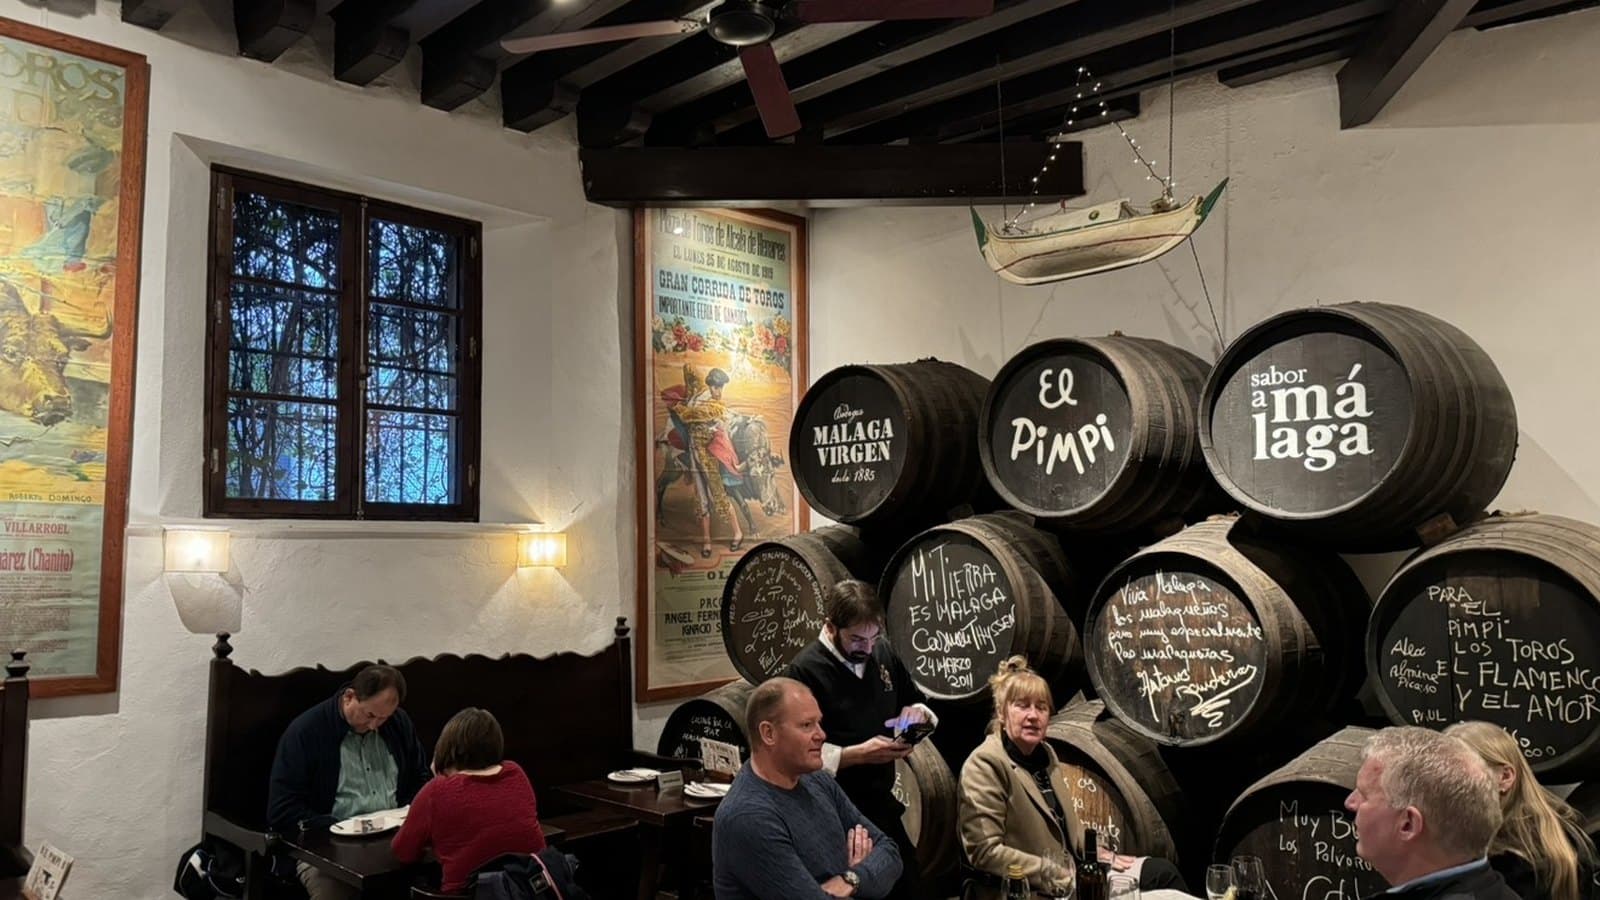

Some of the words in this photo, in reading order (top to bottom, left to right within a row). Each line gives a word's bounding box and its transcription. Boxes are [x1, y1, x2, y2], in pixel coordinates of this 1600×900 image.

[716, 221, 725, 248] de
[659, 270, 688, 292] GRAN
[691, 276, 736, 300] CORRIDA
[739, 285, 751, 303] DE
[753, 289, 785, 310] TOROS
[659, 295, 696, 318] IMPORTANTE
[1039, 367, 1078, 409] El
[1250, 365, 1308, 387] sabor
[1251, 389, 1268, 408] a
[1269, 363, 1375, 423] má
[817, 440, 892, 467] VIRGEN
[1252, 412, 1375, 472] laga
[853, 468, 876, 482] 1885
[49, 494, 92, 503] DOMINGO
[4, 520, 70, 535] VILLARROEL
[1120, 576, 1148, 605] Viva
[1428, 585, 1473, 602] PARA
[909, 605, 931, 626] ES
[1455, 641, 1492, 656] LOS
[1505, 638, 1575, 664] TOROS
[916, 655, 936, 677] 24
[937, 655, 972, 679] MARZO
[947, 672, 973, 688] 2011
[1456, 684, 1472, 712] Y
[1481, 690, 1520, 709] EL
[1527, 694, 1600, 724] AMOR
[1279, 799, 1320, 838] Muy
[1279, 834, 1297, 854] Los
